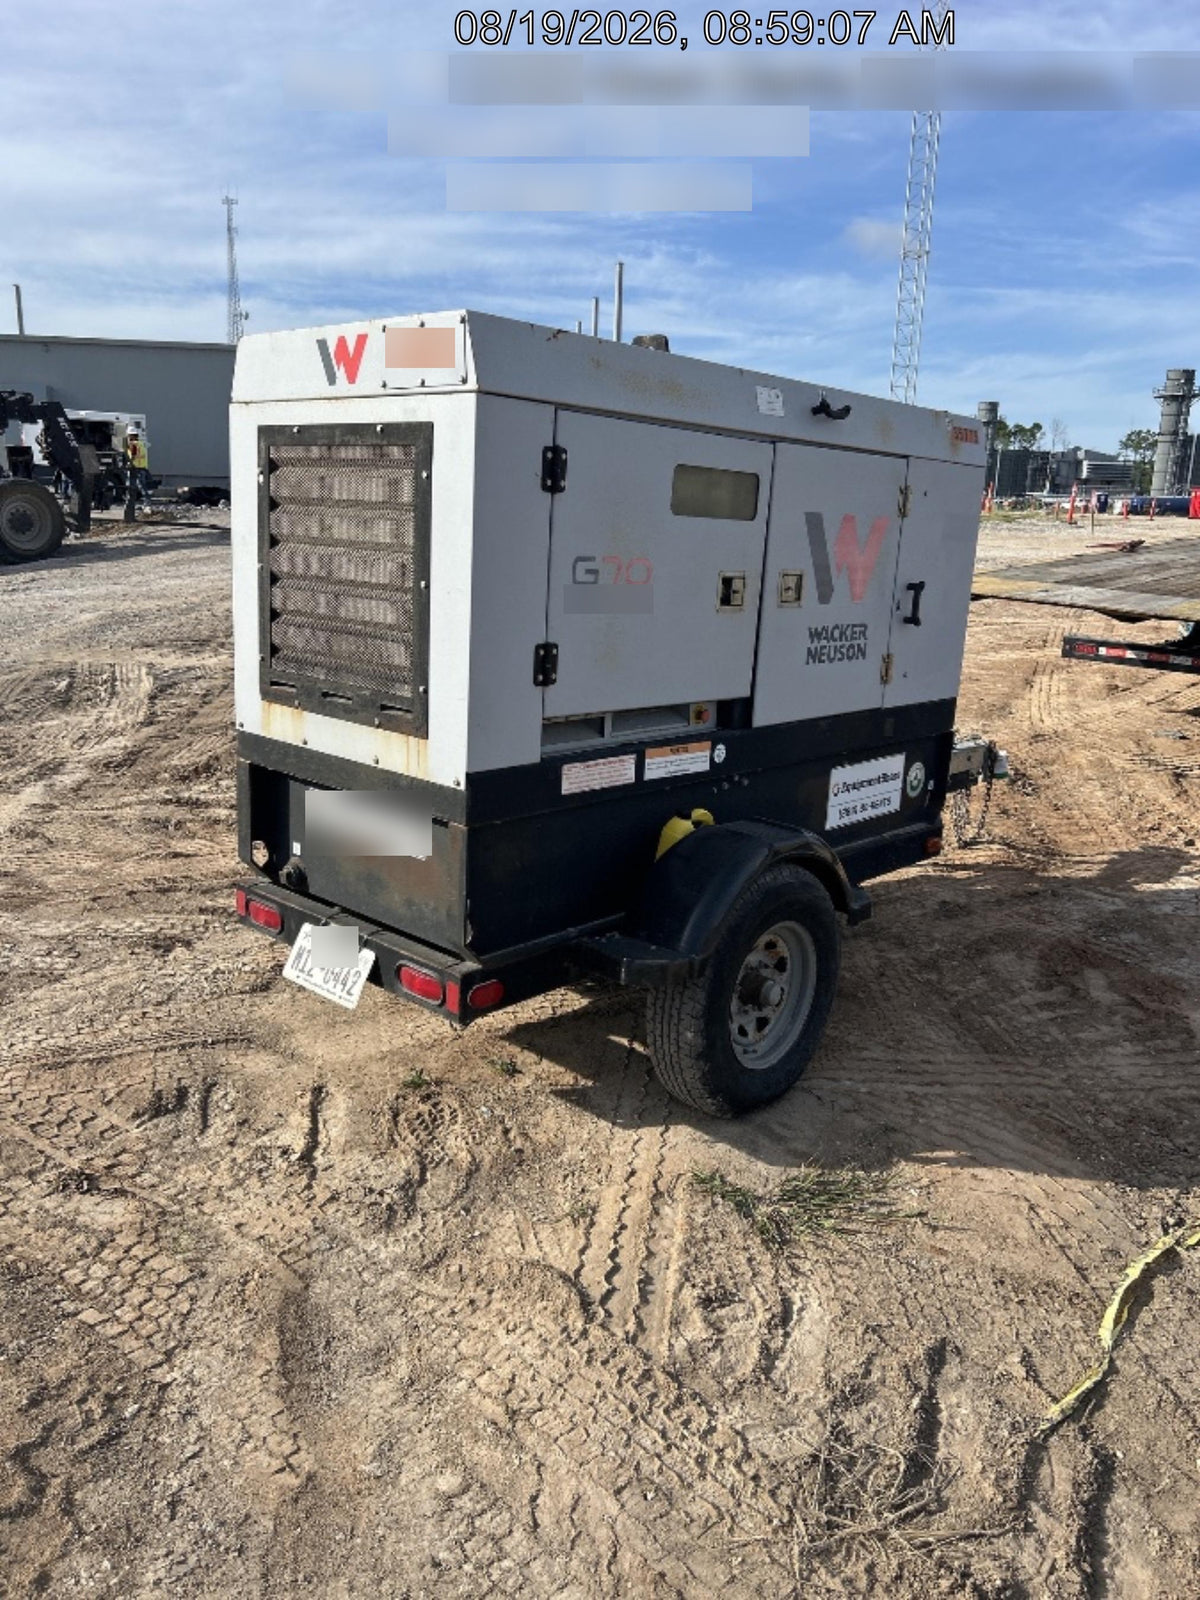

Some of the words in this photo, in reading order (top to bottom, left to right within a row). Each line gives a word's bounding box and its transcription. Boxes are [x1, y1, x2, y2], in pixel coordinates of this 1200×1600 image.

[572, 556, 653, 585] G70
[808, 624, 868, 644] WACKER
[805, 643, 867, 665] NEUSON
